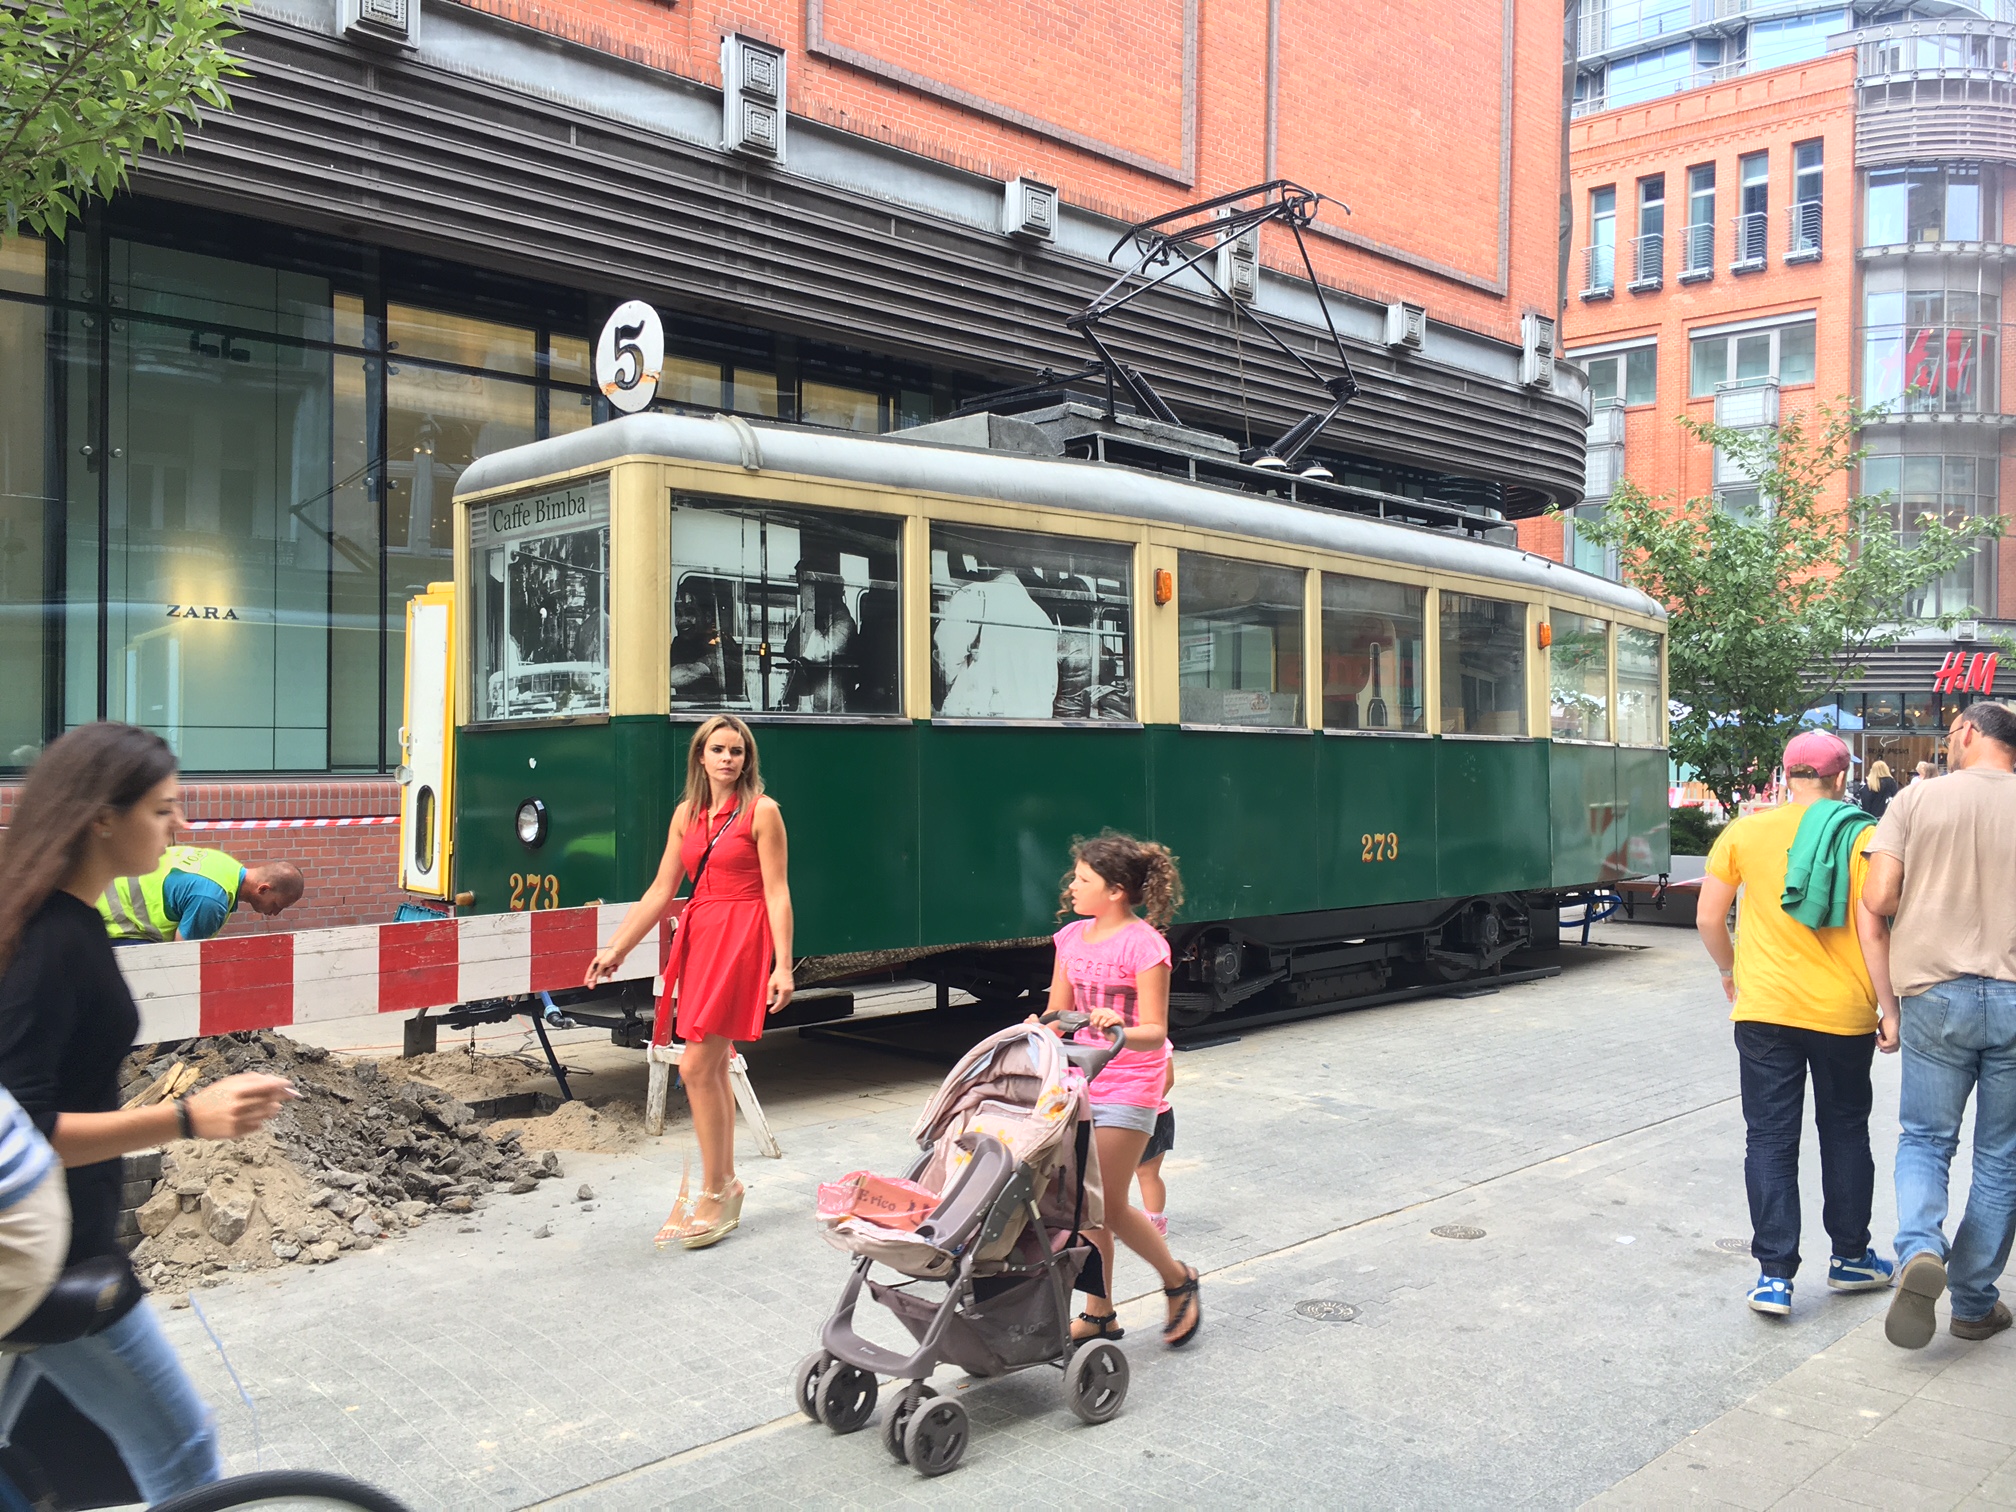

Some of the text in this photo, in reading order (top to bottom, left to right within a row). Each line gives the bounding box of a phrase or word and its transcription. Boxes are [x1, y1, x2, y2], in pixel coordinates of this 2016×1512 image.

[614, 320, 645, 390] 5
[493, 491, 586, 532] Caffe Bimba
[166, 604, 240, 620] ZARA
[1932, 651, 1999, 695] H&M
[1361, 832, 1399, 863] 273
[509, 872, 560, 912] 273
